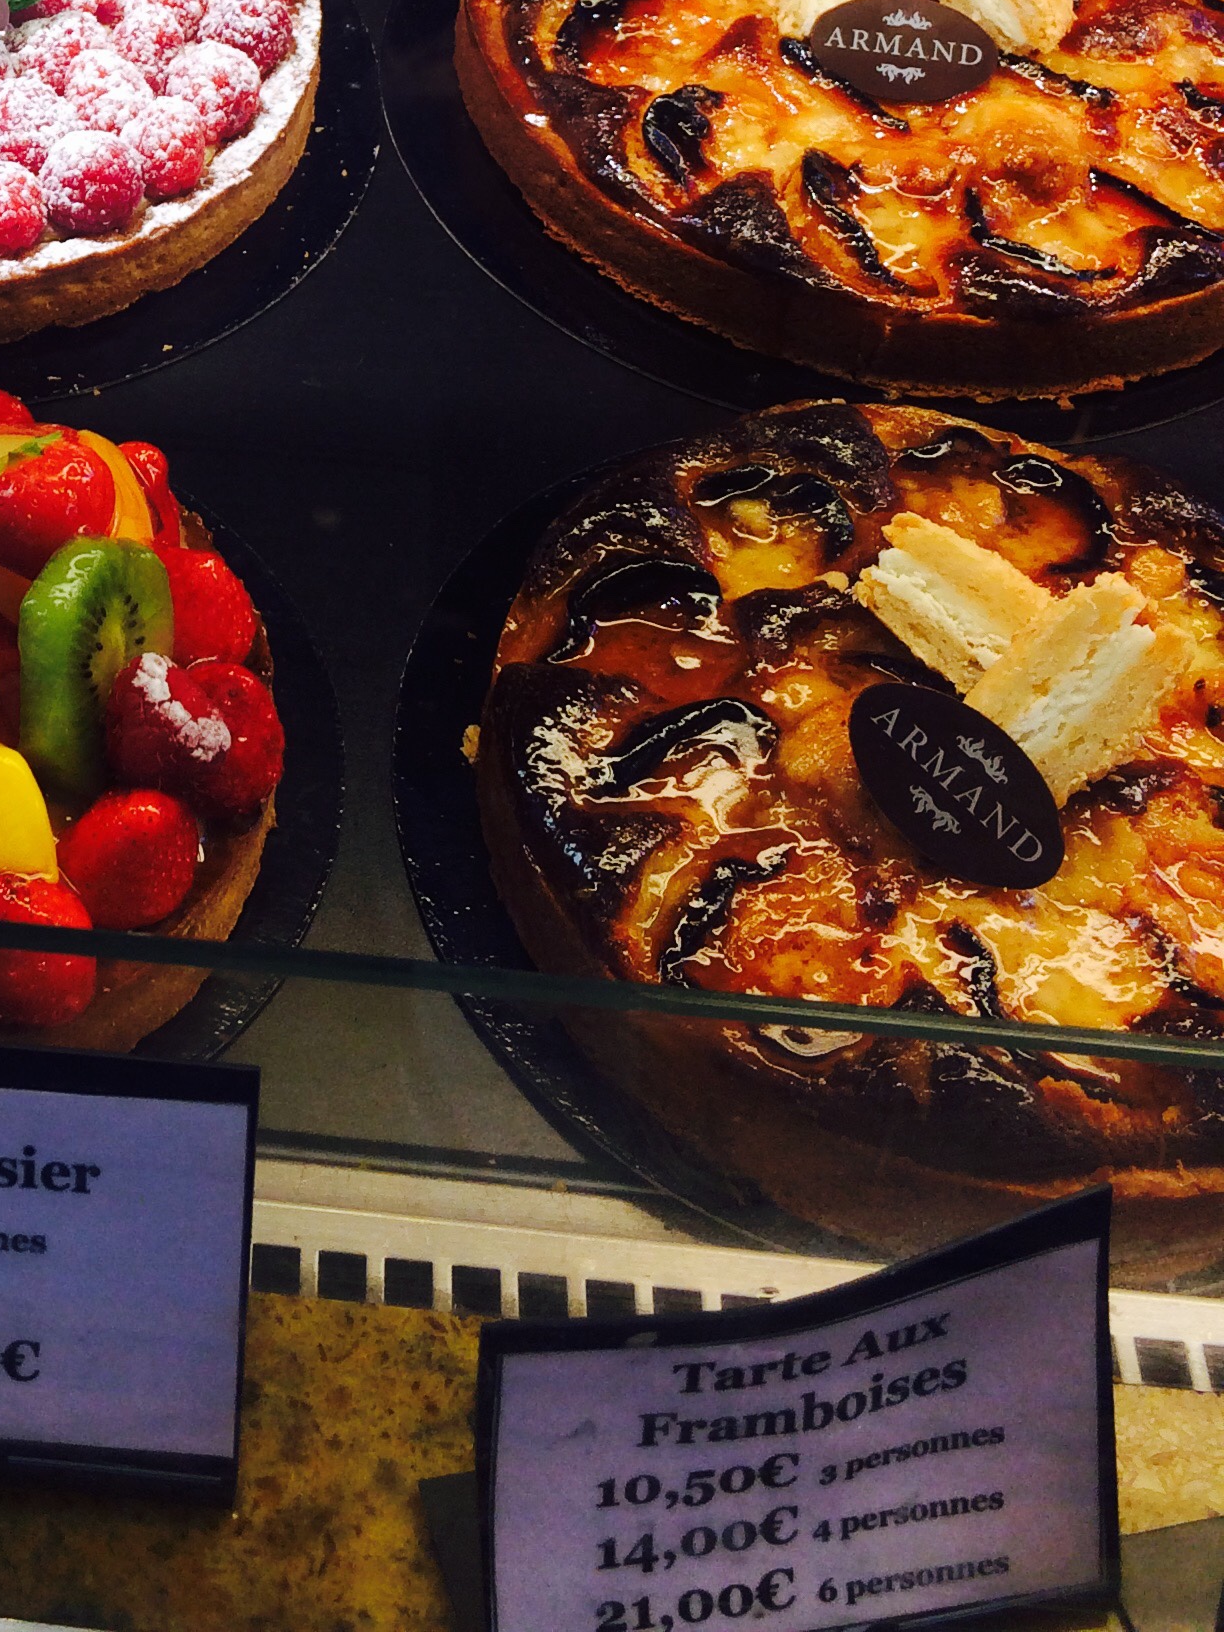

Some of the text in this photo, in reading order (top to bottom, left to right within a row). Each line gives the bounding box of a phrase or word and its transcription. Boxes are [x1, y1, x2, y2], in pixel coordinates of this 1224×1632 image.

[824, 26, 983, 66] ARMAND
[871, 708, 1043, 863] ARMAND
[673, 1311, 951, 1394] Tarte Aux
[636, 1357, 969, 1448] Framboises
[595, 1424, 1006, 1510] 10,50€ 3 personnes
[596, 1491, 1005, 1574] 14,00€ 4 personnes
[595, 1555, 1010, 1632] 21,00€ 6 personnes
